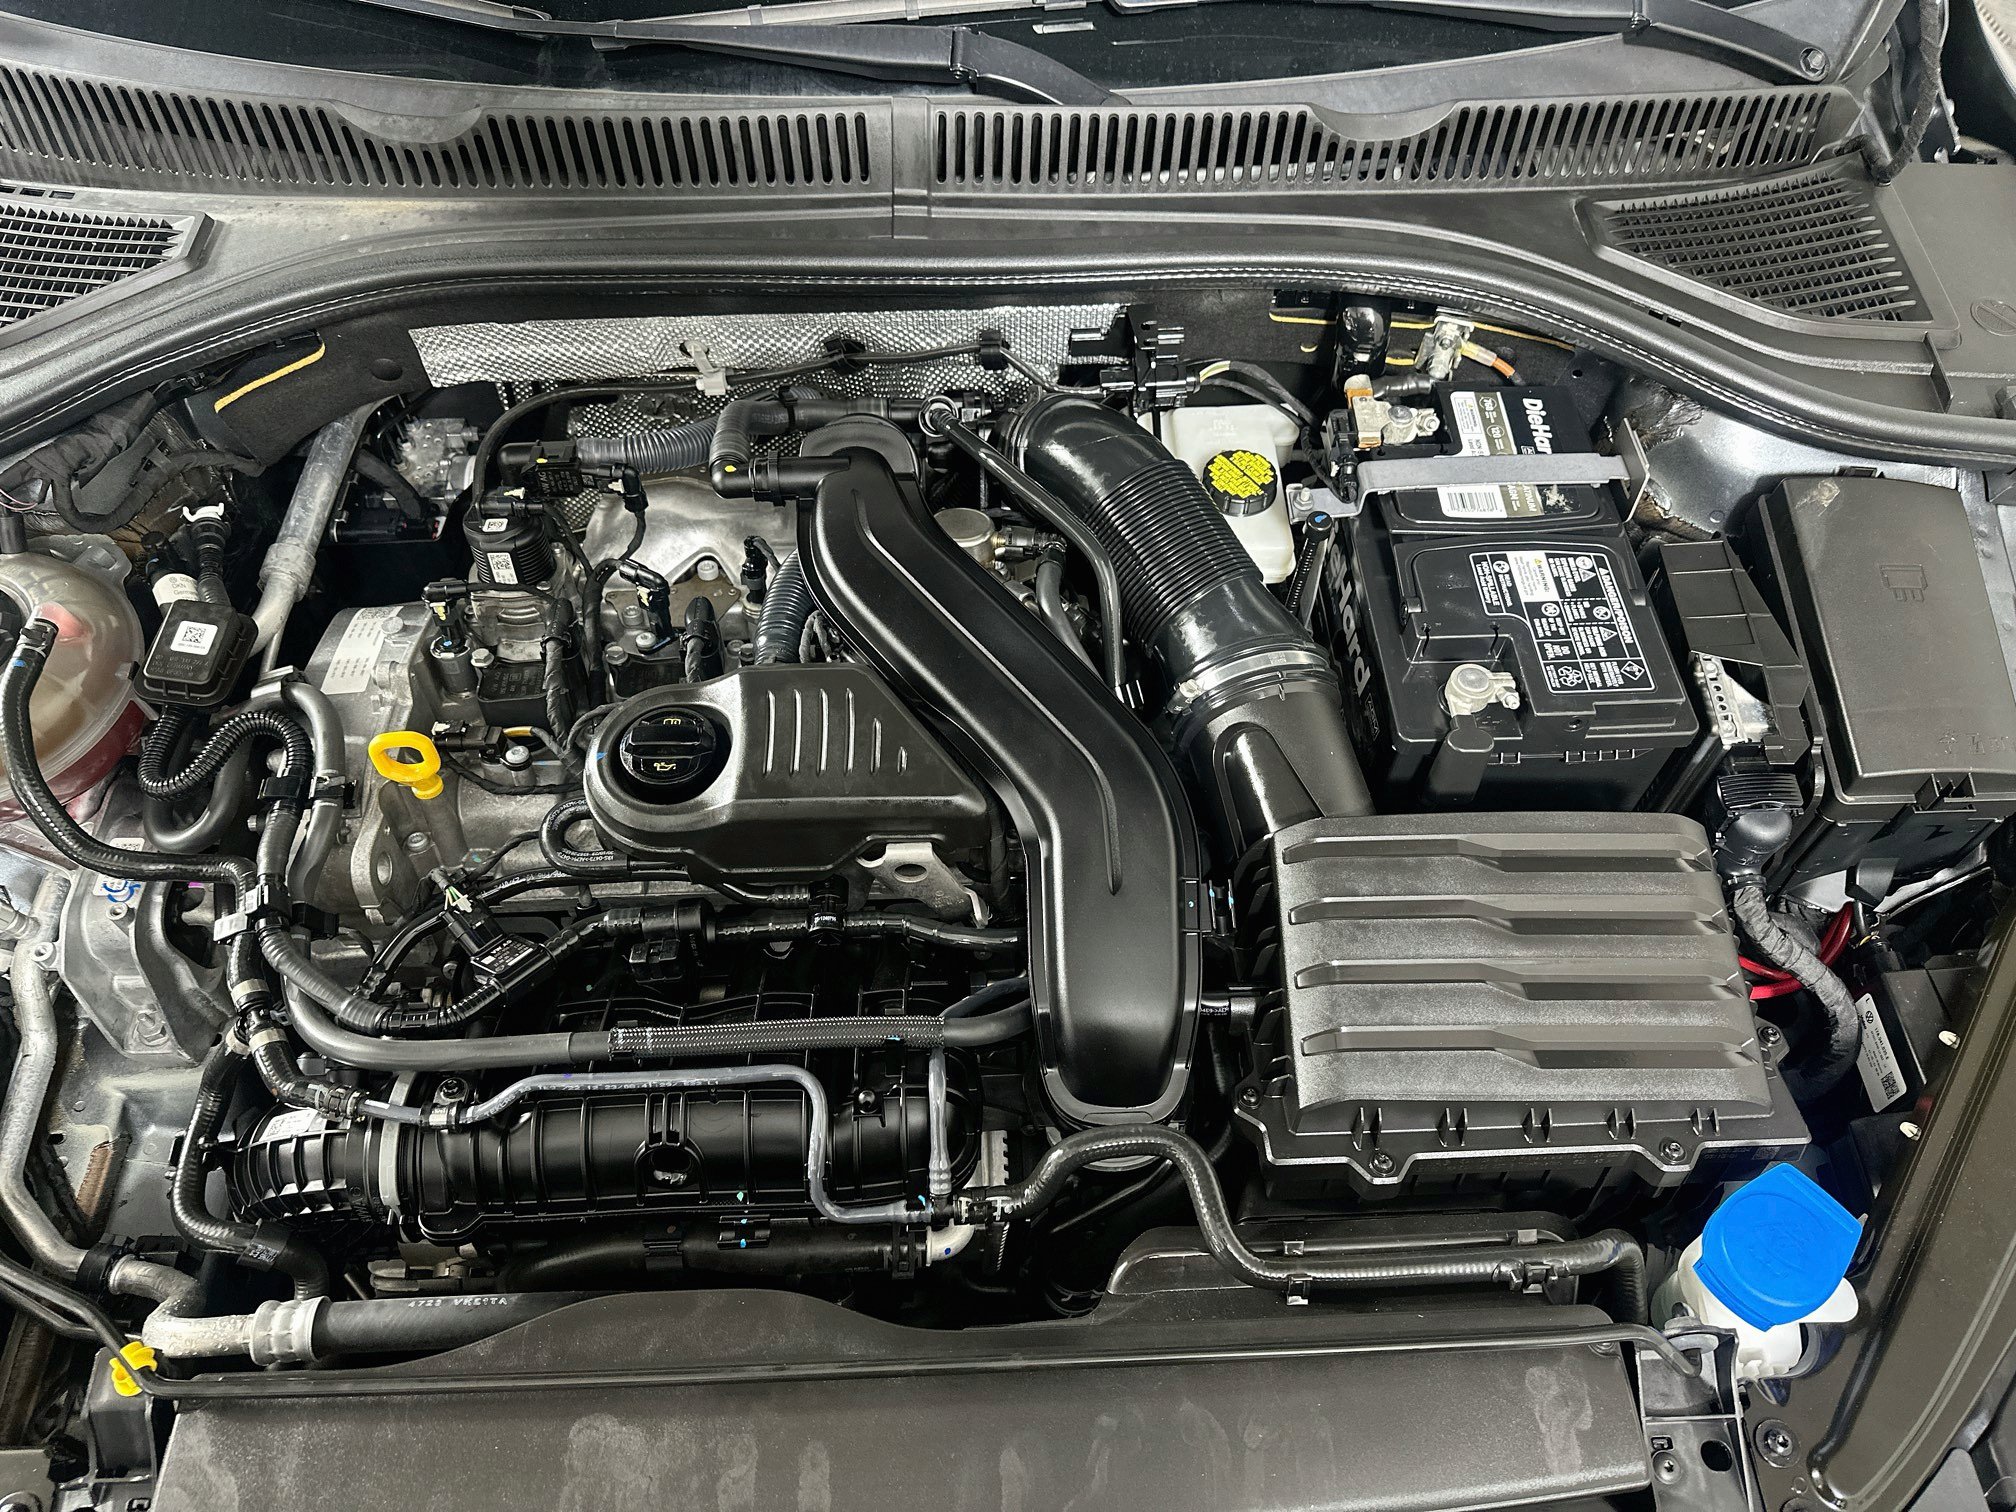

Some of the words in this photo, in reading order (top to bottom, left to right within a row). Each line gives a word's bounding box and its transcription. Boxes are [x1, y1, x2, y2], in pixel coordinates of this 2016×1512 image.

[1491, 427, 1501, 438] 120
[1522, 398, 1552, 454] DieHar
[1523, 484, 1537, 512] ATINUM
[1476, 564, 1484, 575] Lead
[1479, 575, 1487, 586] Acid
[1481, 561, 1500, 606] NON-SPILLABLE
[1504, 574, 1512, 587] READ
[1538, 565, 1549, 592] WARNING:
[1482, 587, 1491, 603] Battery
[1327, 520, 1371, 697] ieHard
[1602, 575, 1634, 644] DANGER/POISON
[1553, 645, 1563, 656] NOT
[1561, 646, 1570, 654] DO
